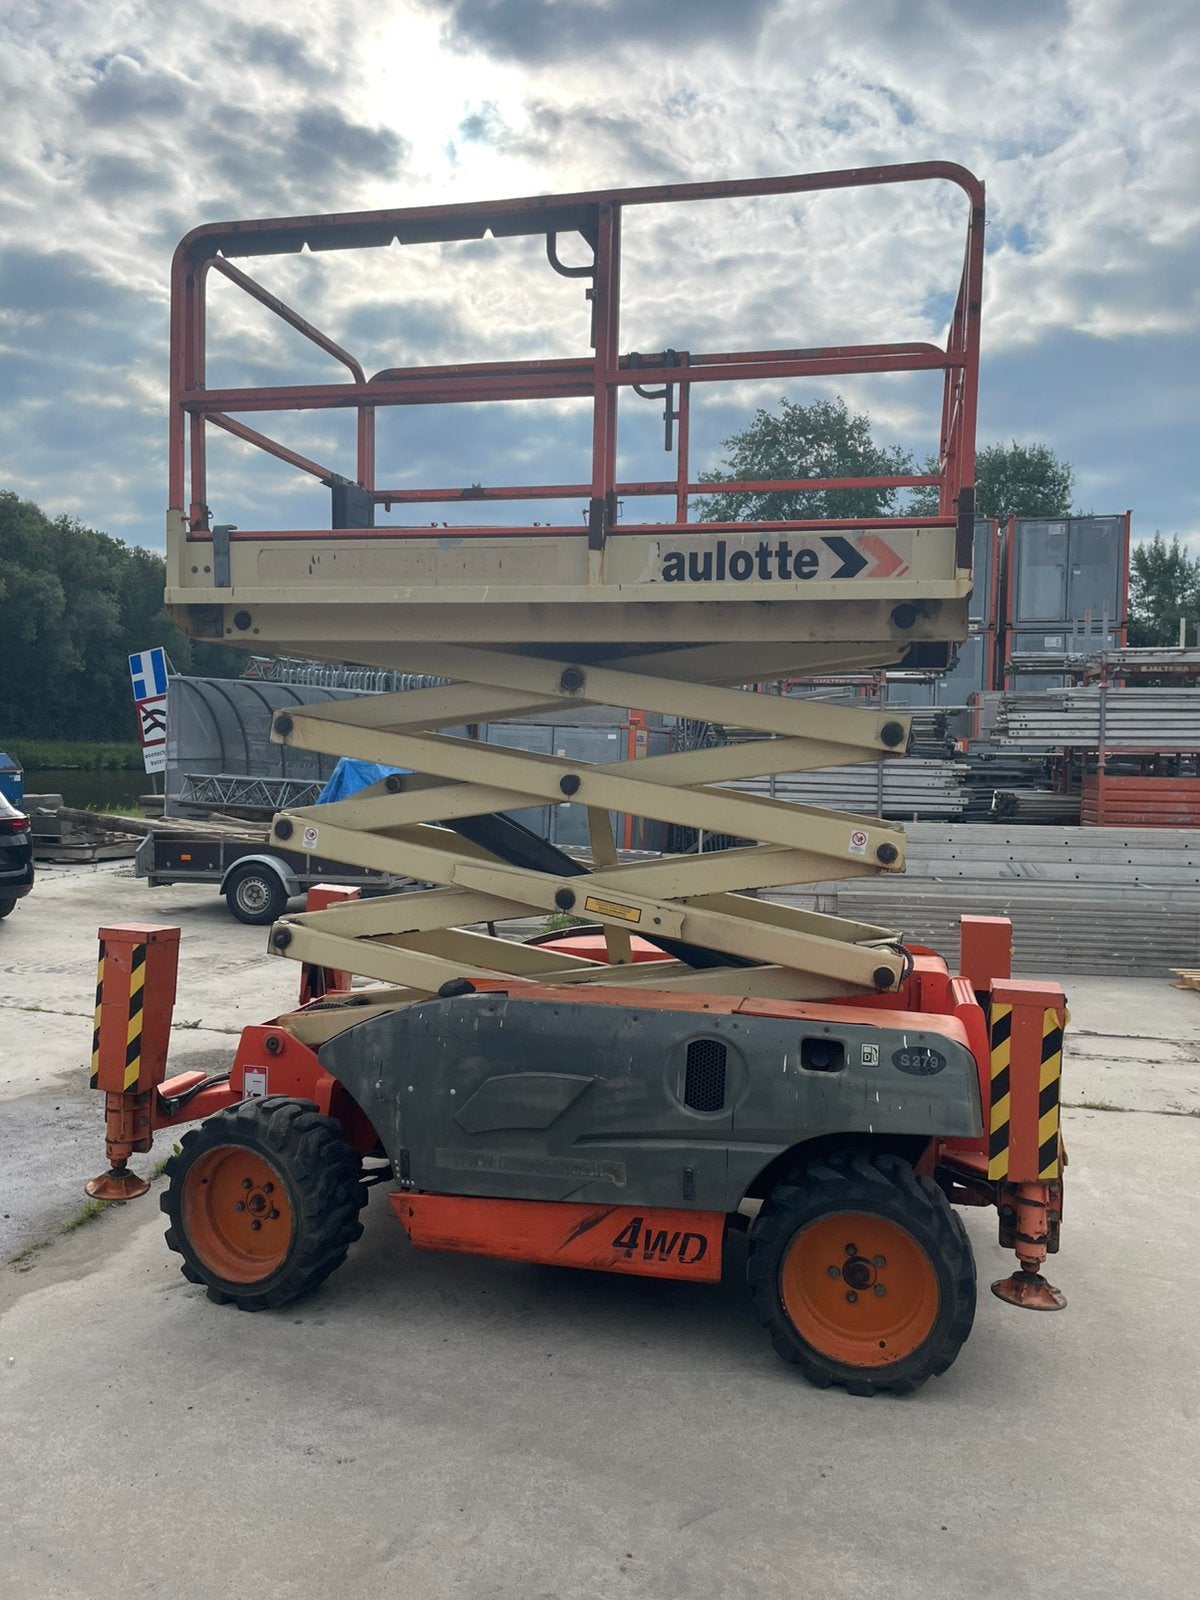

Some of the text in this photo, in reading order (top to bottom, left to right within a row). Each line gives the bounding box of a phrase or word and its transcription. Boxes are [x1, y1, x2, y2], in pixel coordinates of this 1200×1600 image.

[657, 541, 819, 582] aulotte
[864, 1053, 872, 1061] D
[612, 1217, 708, 1264] 4WD
